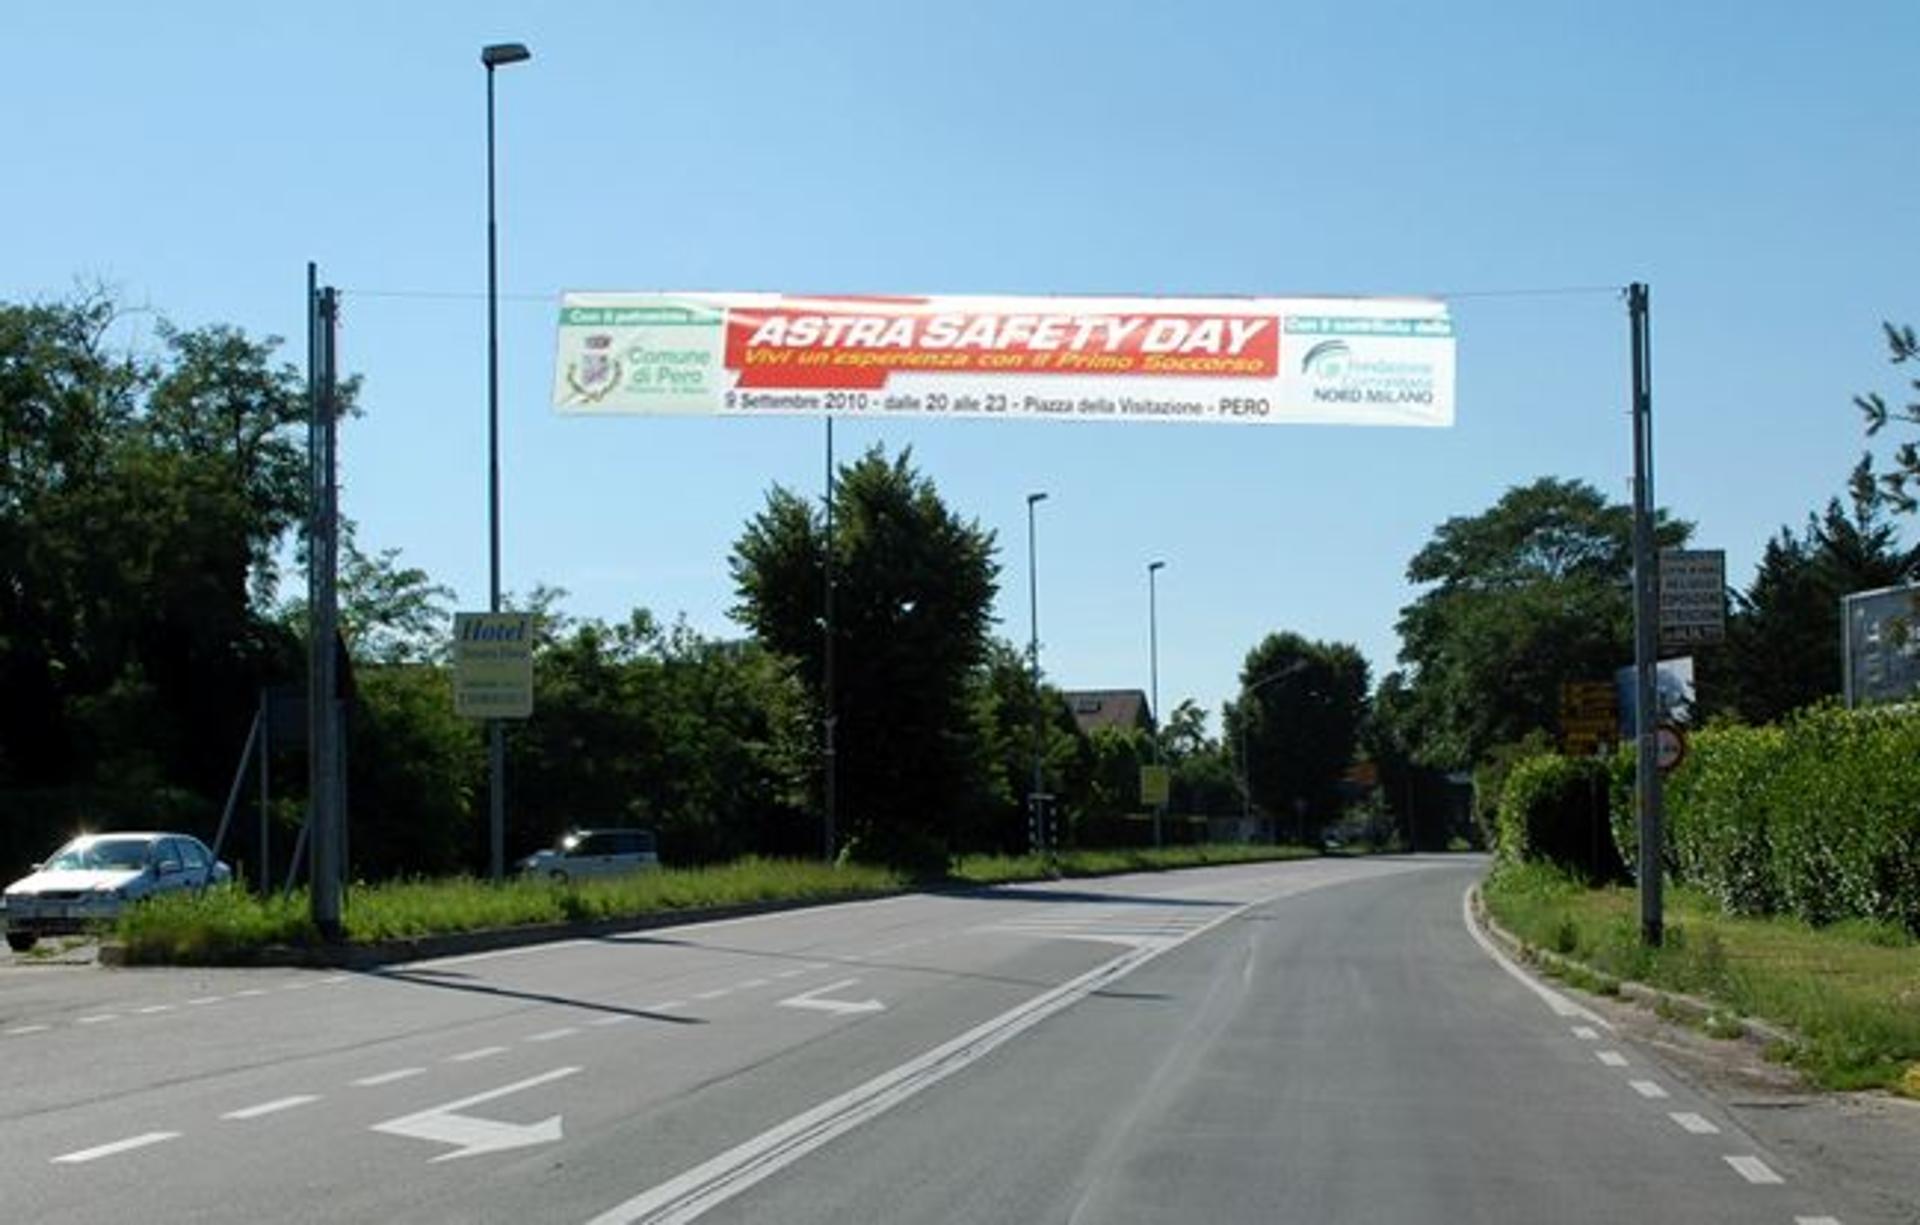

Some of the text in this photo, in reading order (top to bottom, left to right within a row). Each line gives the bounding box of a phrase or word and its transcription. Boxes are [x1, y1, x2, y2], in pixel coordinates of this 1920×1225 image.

[750, 315, 1271, 354] ASTRA SAFETY DAY
[629, 347, 710, 365] Comune
[744, 348, 794, 364] Vivi
[978, 353, 1023, 368] con
[1031, 353, 1050, 368] il
[1056, 353, 1135, 370] Primo
[1141, 355, 1265, 373] Soccorso
[633, 366, 703, 383] di Pero
[725, 391, 737, 409] 9
[741, 393, 819, 409] Settembre
[824, 393, 868, 410] 2010
[884, 394, 920, 410] dalle
[926, 393, 949, 411] 20
[953, 395, 980, 411] alle
[985, 394, 1008, 412] 23
[1024, 395, 1074, 413] Piazza
[1077, 396, 1115, 413] della
[1119, 397, 1204, 415] Visitazione
[1218, 398, 1271, 416] PERO
[1313, 388, 1434, 404] NORD MILANO
